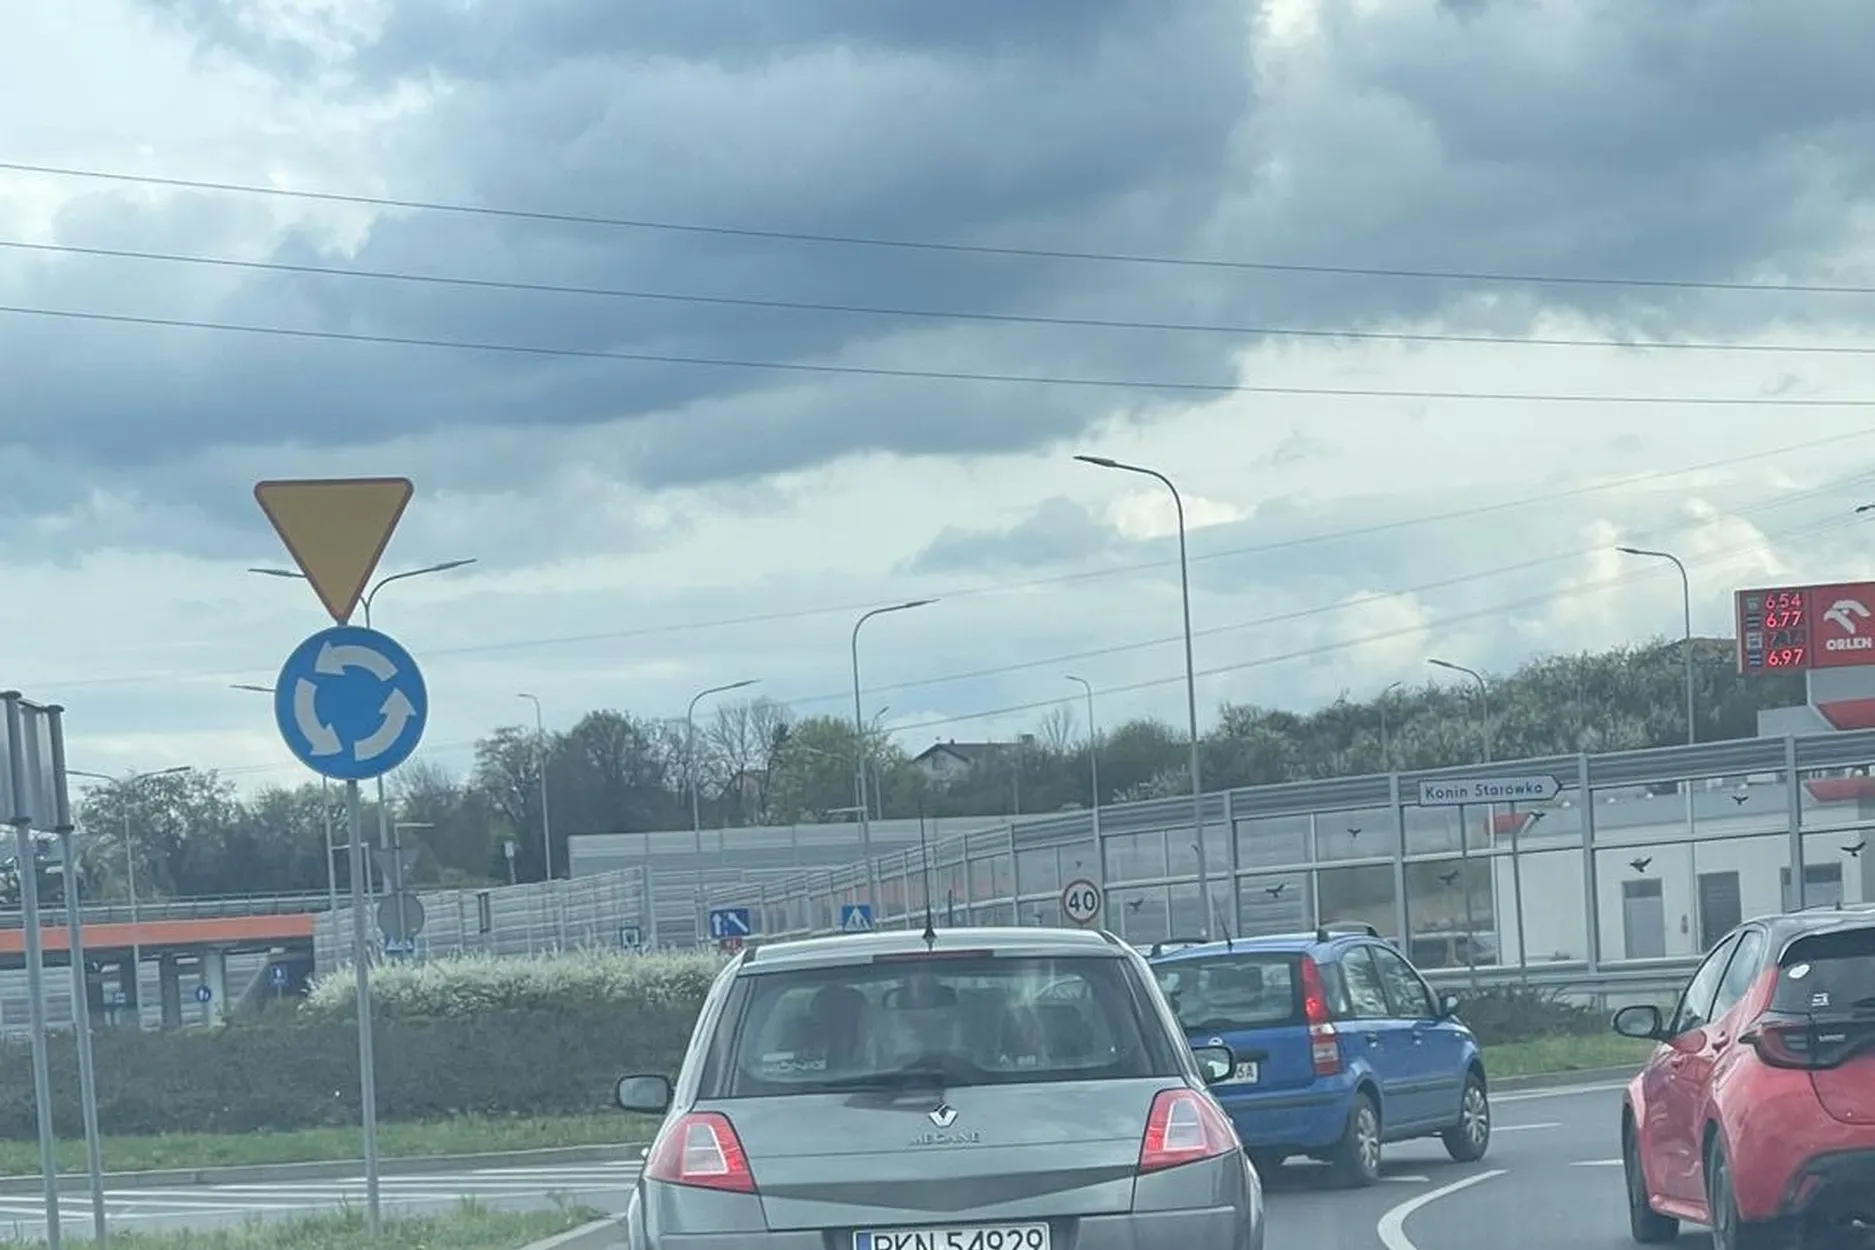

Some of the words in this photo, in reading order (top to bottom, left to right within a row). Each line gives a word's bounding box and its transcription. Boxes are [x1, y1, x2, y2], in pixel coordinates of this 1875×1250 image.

[1825, 637, 1872, 651] ORLEN
[1768, 649, 1803, 666] 6.97
[1425, 786, 1468, 800] Konin
[1069, 891, 1096, 911] 40
